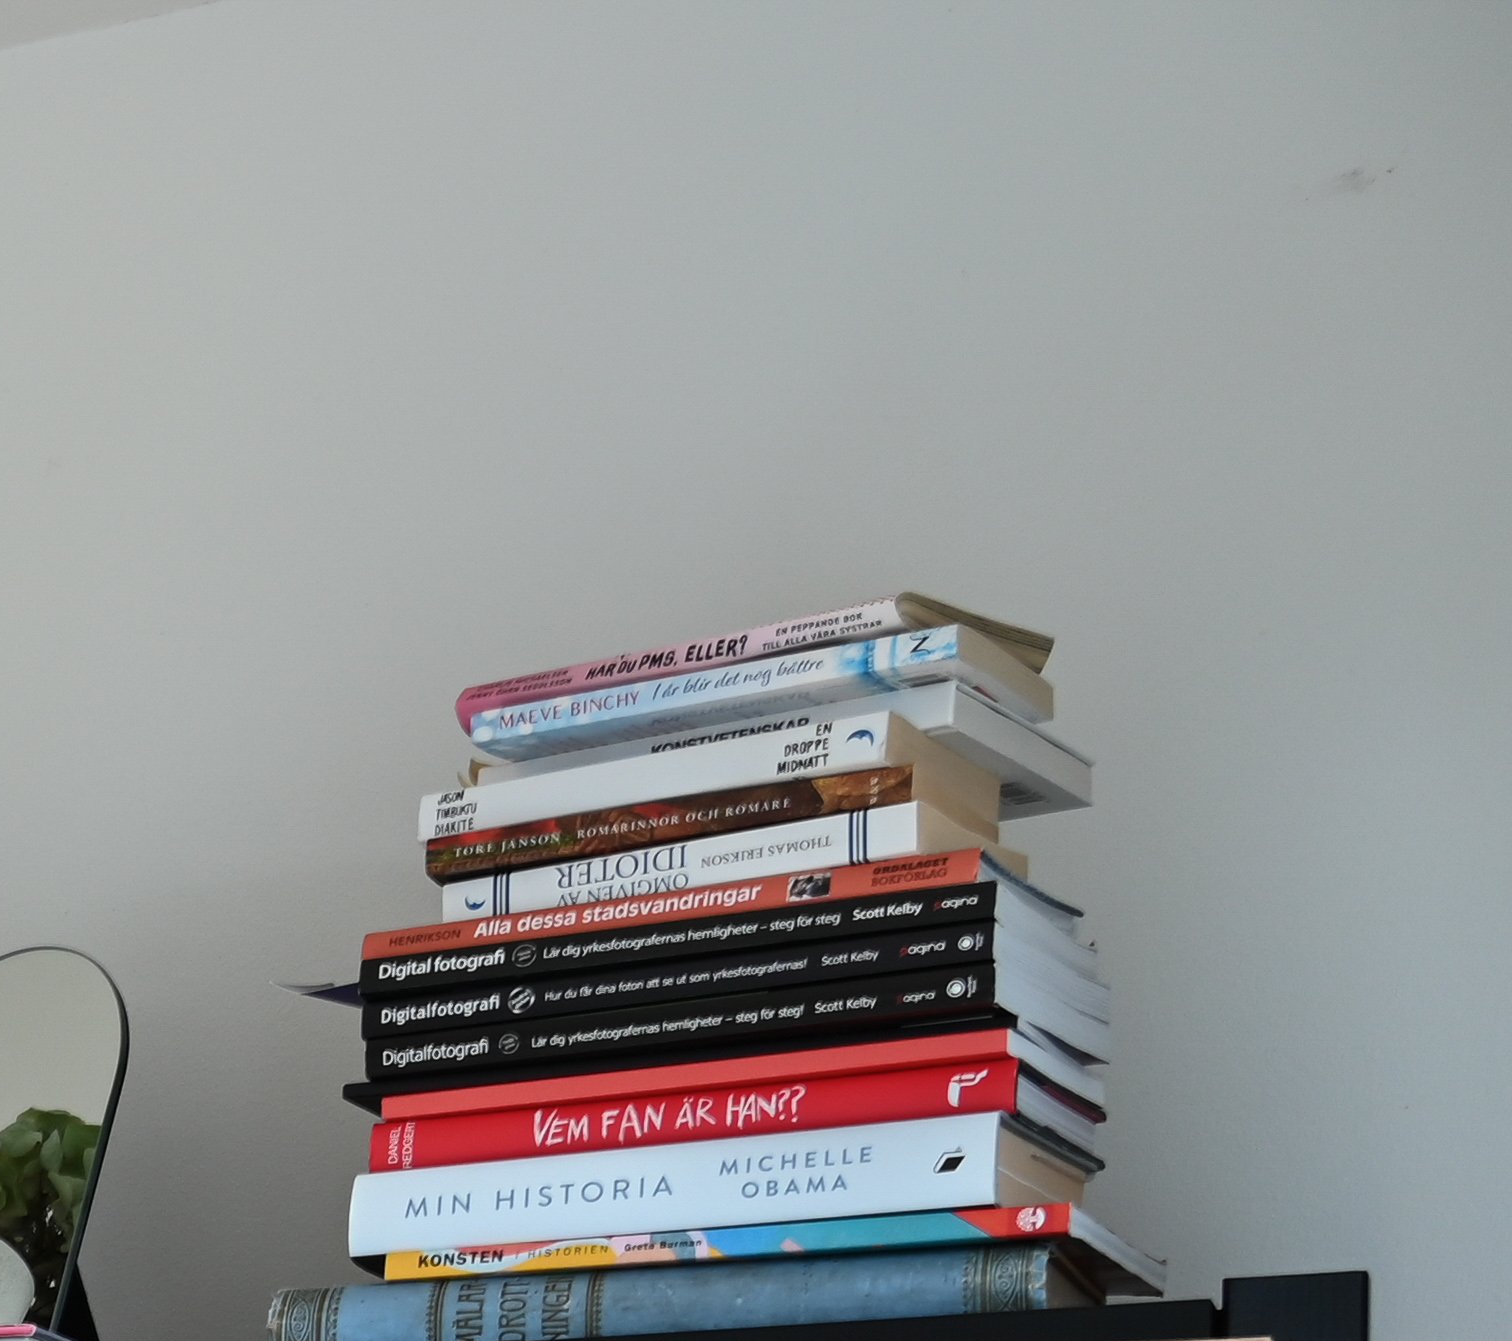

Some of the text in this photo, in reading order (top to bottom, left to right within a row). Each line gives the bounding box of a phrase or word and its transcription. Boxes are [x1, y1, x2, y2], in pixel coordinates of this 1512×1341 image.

[761, 619, 883, 651] TILL ALLA VÅRA SYSTRAR
[775, 612, 864, 638] EN PEPPANDE BOK
[684, 635, 749, 663] ELLER?
[682, 674, 710, 695] blir
[714, 669, 740, 690] det
[743, 665, 771, 687] nog
[776, 658, 825, 677] bättre
[499, 703, 562, 730] MAEVE
[570, 691, 640, 717] BINCHY
[815, 722, 833, 736] EN
[784, 738, 830, 758] DROPPE
[776, 753, 830, 775] MIDNATT
[453, 797, 792, 858] TORE JANSON ROMARINNOR OCH ROMARE
[556, 844, 689, 890] IDIOTER
[701, 835, 832, 869] THOMAS ERIKSON
[873, 857, 949, 875] ORDALAGET
[474, 884, 762, 939] Alla dessa stadsvandringar
[852, 901, 924, 922] Scott Kelby
[388, 929, 462, 948] HENRIKSON
[543, 946, 561, 960] Lär
[562, 944, 581, 959] dig
[581, 931, 686, 957] yrkesfotografernas
[687, 922, 758, 942] hemligheter
[769, 918, 795, 933] steg
[794, 914, 814, 929] för
[814, 912, 842, 928] steg
[378, 955, 432, 981] Digital
[433, 948, 506, 974] fotografi
[821, 950, 880, 968] Scott Kelby
[544, 990, 562, 1003] Hur
[564, 989, 577, 1000] du
[595, 984, 616, 996] dina
[618, 980, 644, 993] foton
[646, 978, 660, 989] att
[662, 977, 673, 987] se
[676, 975, 687, 985] ut
[689, 972, 710, 984] som
[814, 997, 878, 1015] Scott Kelby
[531, 1035, 547, 1049] Lär
[549, 1034, 565, 1048] dig
[568, 1021, 661, 1046] yrkesfotografernas
[662, 1014, 724, 1033] hemligheter
[735, 1010, 758, 1025] steg
[760, 1008, 776, 1021] för
[532, 1084, 807, 1147] VEM FAN ÄR HAN??
[387, 1124, 402, 1165] DANIEL
[718, 1145, 874, 1177] MICHELLE
[404, 1175, 674, 1219] MIN HISTORIA
[741, 1174, 849, 1199] OBAMA
[418, 1250, 504, 1269] KONSTEN
[527, 1245, 609, 1260] HISTORIEN
[624, 1241, 656, 1253] Greta
